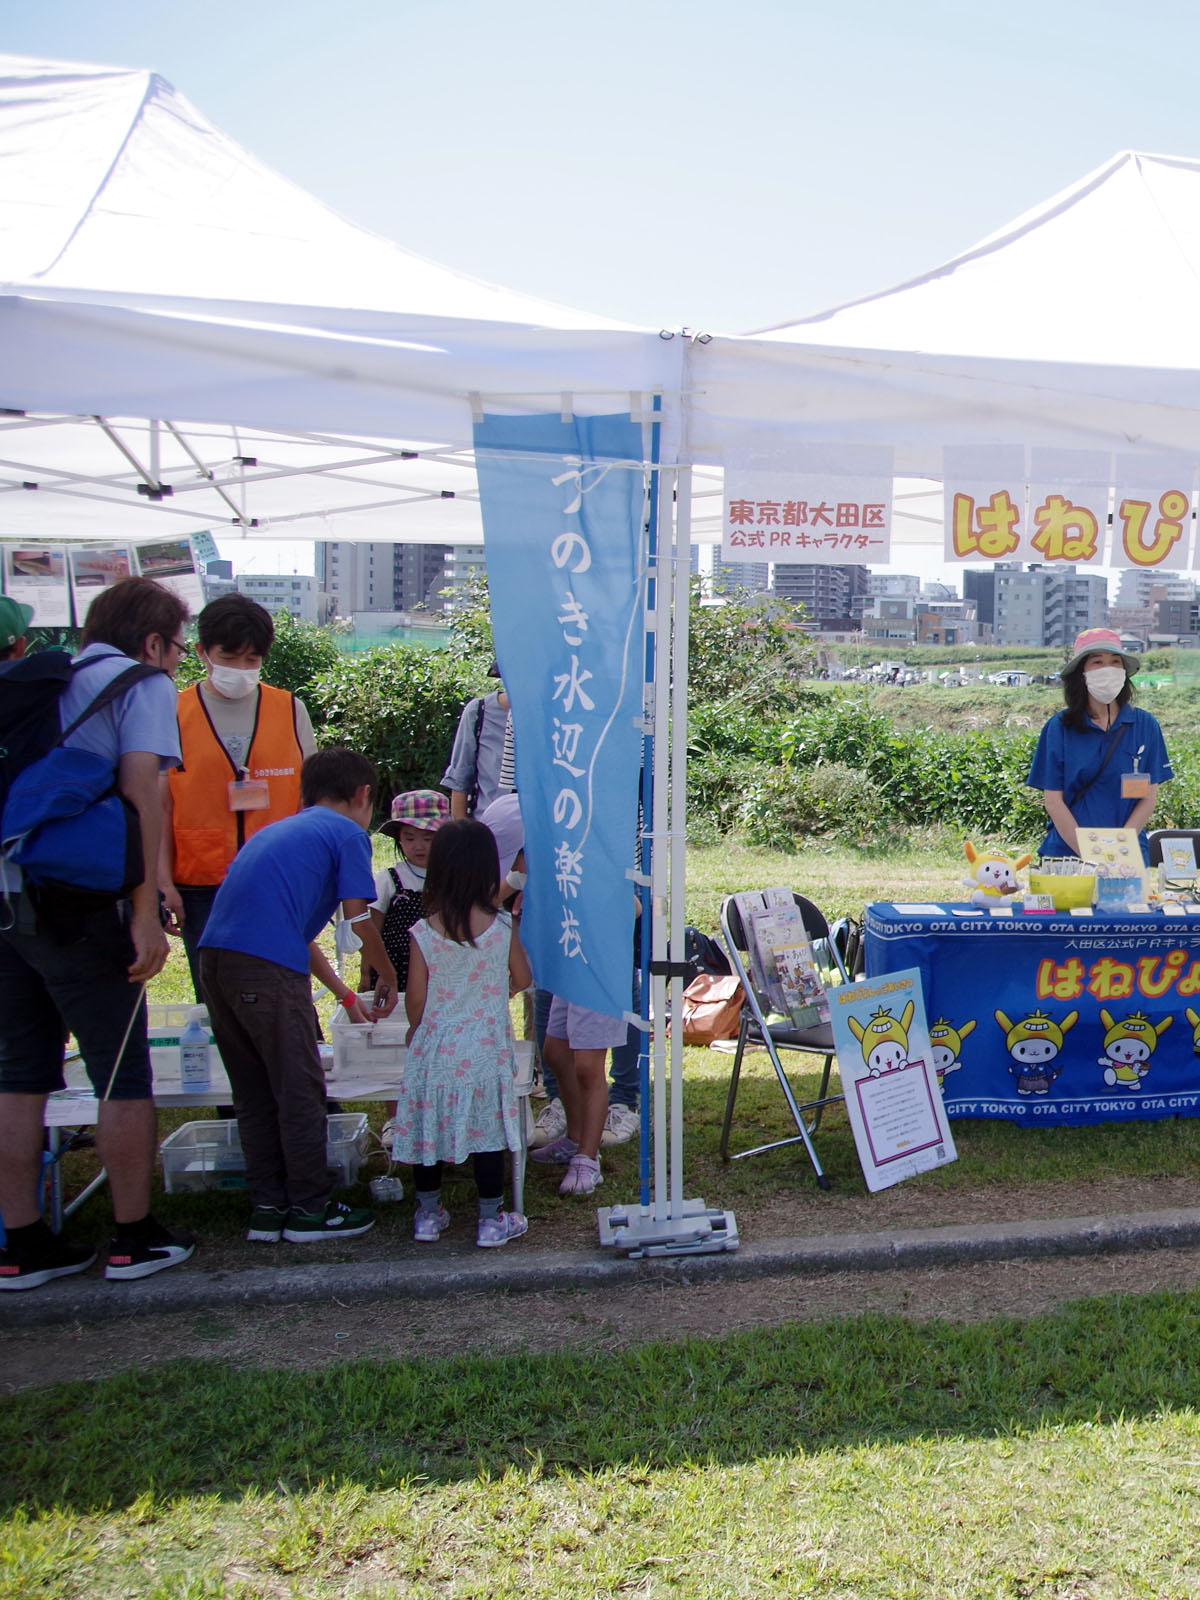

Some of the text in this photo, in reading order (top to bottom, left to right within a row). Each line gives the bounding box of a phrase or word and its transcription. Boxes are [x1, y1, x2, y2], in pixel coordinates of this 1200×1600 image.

[729, 499, 886, 528] 東京都大田区
[930, 922, 957, 932] OTA
[961, 921, 993, 932] CITY
[996, 921, 1043, 932] TOKYO
[1049, 923, 1075, 933] OTA
[1079, 924, 1109, 933] CITY
[1113, 924, 1158, 933] TOKYO
[1163, 924, 1188, 932] OTA
[947, 1104, 977, 1114] CITY
[981, 1103, 1026, 1115] TOKYO
[1033, 1105, 1057, 1115] OTA
[1061, 1104, 1091, 1114] CITY
[1094, 1101, 1136, 1112] TOKYO
[1141, 1100, 1166, 1109] OTA
[1169, 1097, 1198, 1108] CITY
